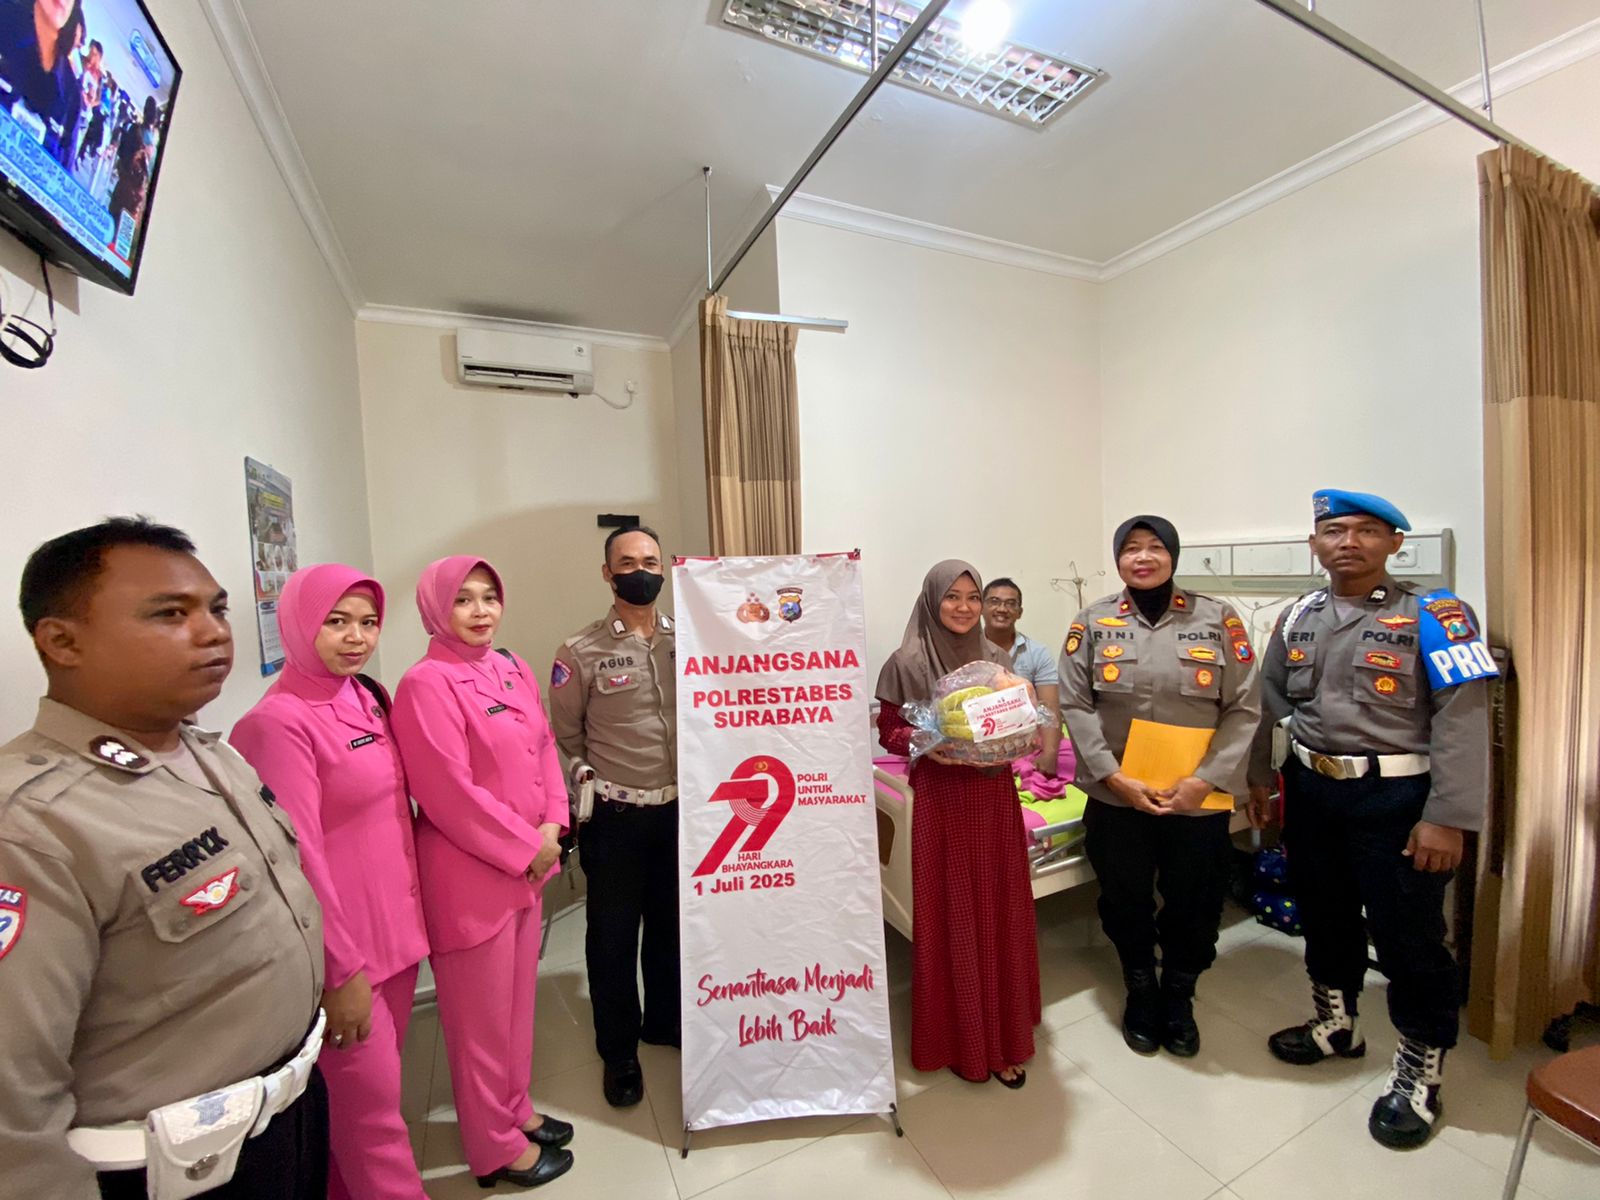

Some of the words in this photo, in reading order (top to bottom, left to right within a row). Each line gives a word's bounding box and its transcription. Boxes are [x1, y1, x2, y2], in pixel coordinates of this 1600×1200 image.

[1093, 631, 1135, 641] RINI
[1178, 631, 1222, 642] POLRI
[1362, 629, 1415, 647] POLRI
[598, 656, 634, 671] AGUS
[684, 649, 860, 676] ANJANGSANA
[1428, 641, 1498, 684] PRO
[693, 683, 853, 708] POLRESTABES
[714, 706, 834, 729] SURABAYA
[797, 773, 828, 783] POLRI
[797, 784, 833, 794] UNTUK
[797, 794, 867, 806] MASYARAKAT
[737, 852, 761, 862] HARI
[721, 859, 794, 873] BHAYANGKARA
[693, 881, 703, 896] 1
[710, 876, 744, 894] Juli
[750, 872, 796, 890] 2025
[697, 968, 800, 1007] Senantiasa
[804, 962, 875, 1002] Menjadi
[739, 1014, 784, 1047] Lebih
[788, 1007, 838, 1042] Baik
